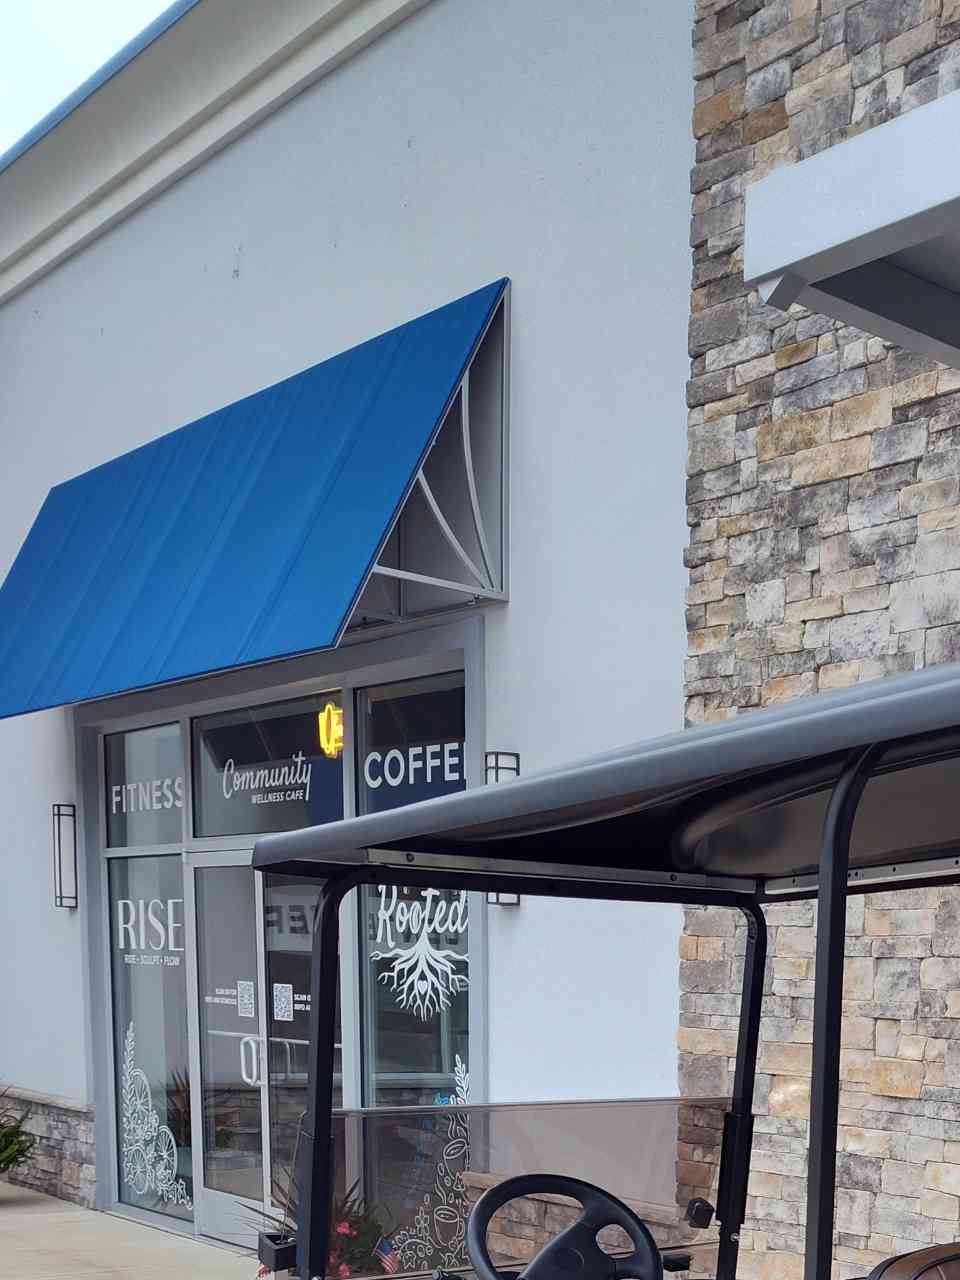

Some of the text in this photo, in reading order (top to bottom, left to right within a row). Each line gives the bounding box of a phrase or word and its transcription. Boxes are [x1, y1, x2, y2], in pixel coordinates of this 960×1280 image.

[222, 751, 312, 801] Community
[364, 742, 467, 788] COFFE
[111, 776, 184, 814] FITNESS
[286, 790, 304, 801] CAFE
[118, 899, 184, 950] RISE
[375, 884, 468, 948] Rooted
